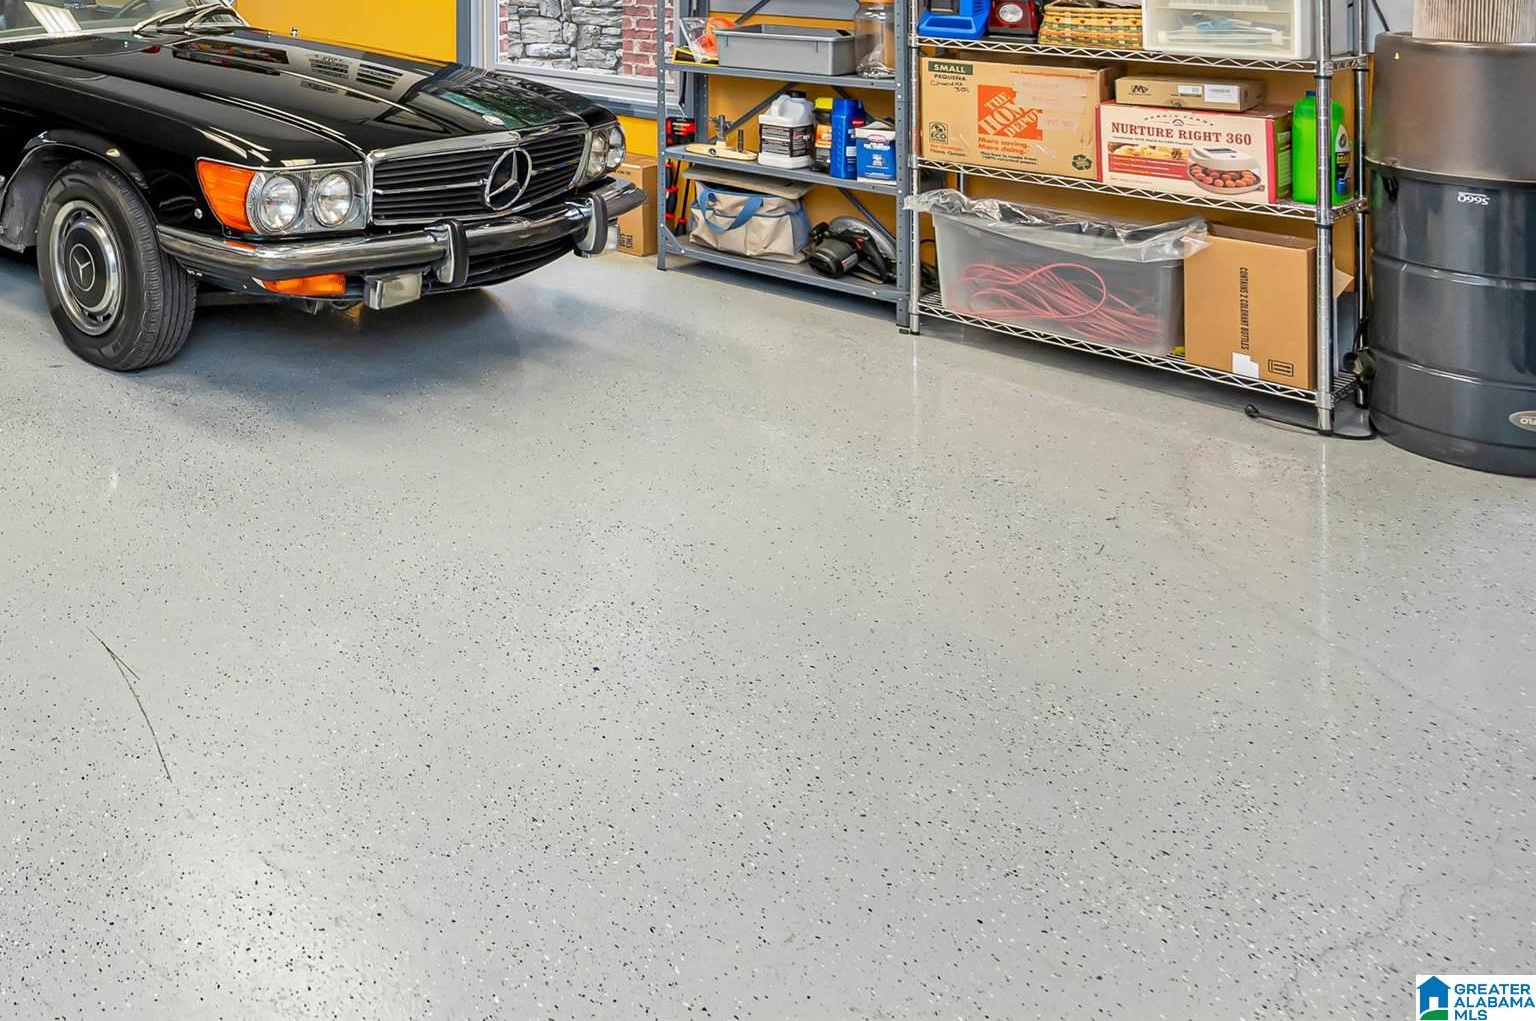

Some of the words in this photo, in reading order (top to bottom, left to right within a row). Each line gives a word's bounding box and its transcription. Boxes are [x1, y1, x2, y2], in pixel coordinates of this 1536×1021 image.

[934, 63, 966, 74] SMALL
[984, 91, 1009, 111] THE
[930, 132, 947, 140] ECO
[978, 137, 999, 145] More
[1111, 121, 1174, 138] NURTURE
[1178, 129, 1222, 143] RIGHT
[1226, 132, 1252, 146] 360
[978, 143, 999, 151] More
[1240, 267, 1249, 293] CONTAINS
[1240, 299, 1249, 327] COLORANT
[1240, 327, 1250, 350] BOTTLES
